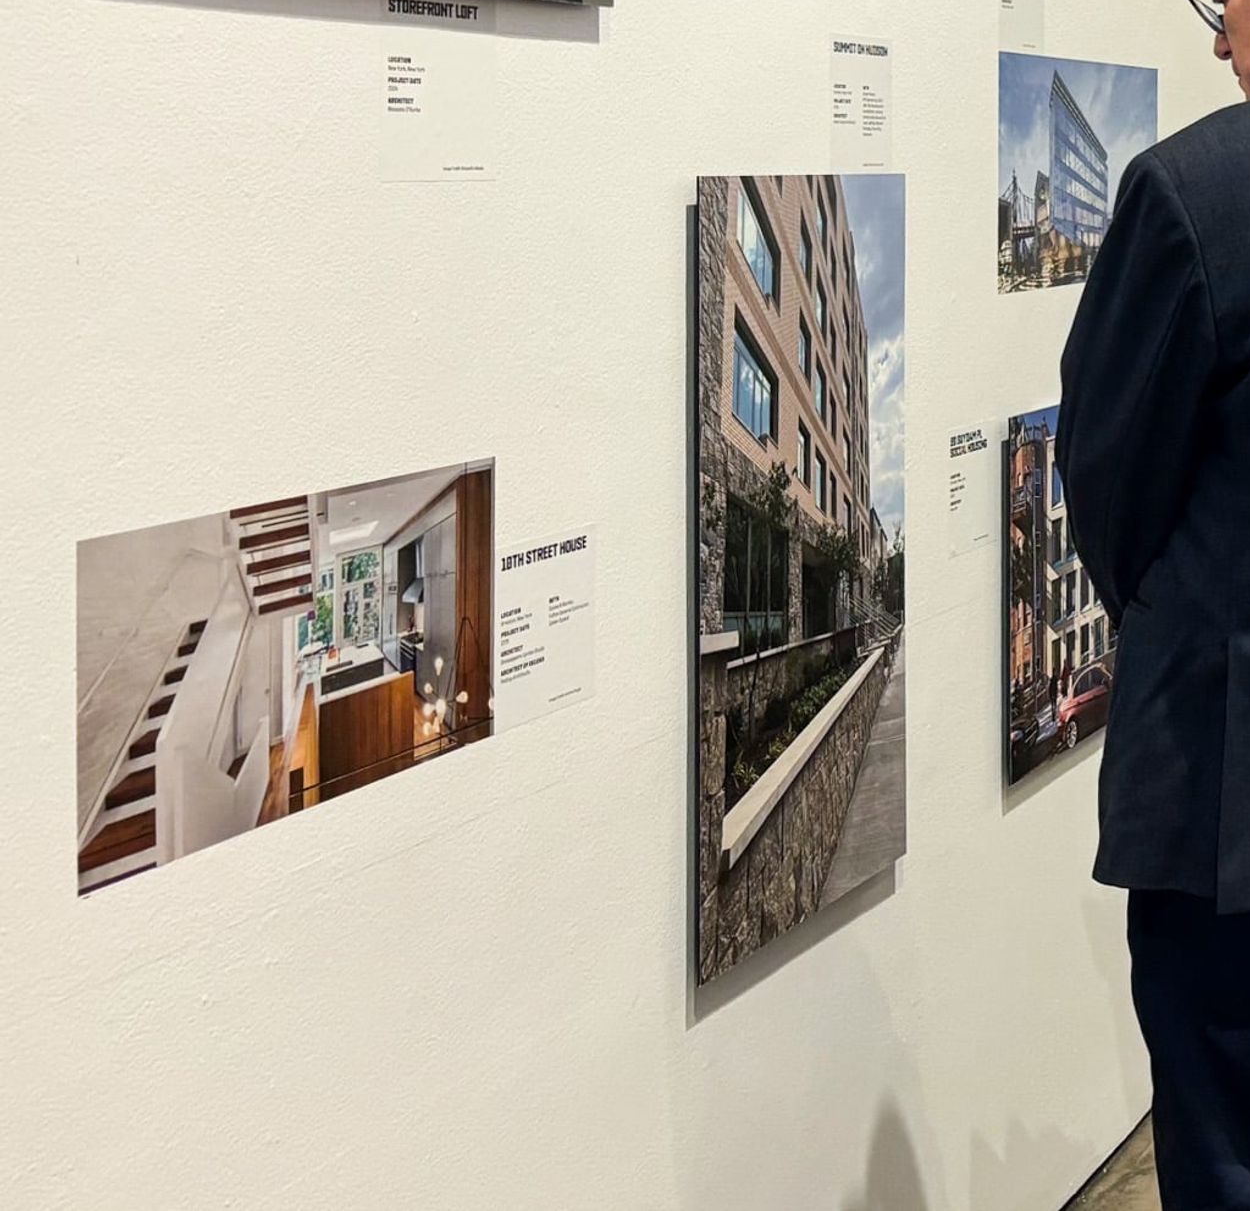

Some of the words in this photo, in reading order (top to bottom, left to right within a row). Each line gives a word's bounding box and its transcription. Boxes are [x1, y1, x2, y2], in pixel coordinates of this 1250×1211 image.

[455, 5, 478, 21] LOFT
[833, 41, 856, 54] SUMMIT
[501, 552, 524, 573] 10TH
[525, 543, 558, 565] STREET
[559, 535, 588, 556] HOUSE
